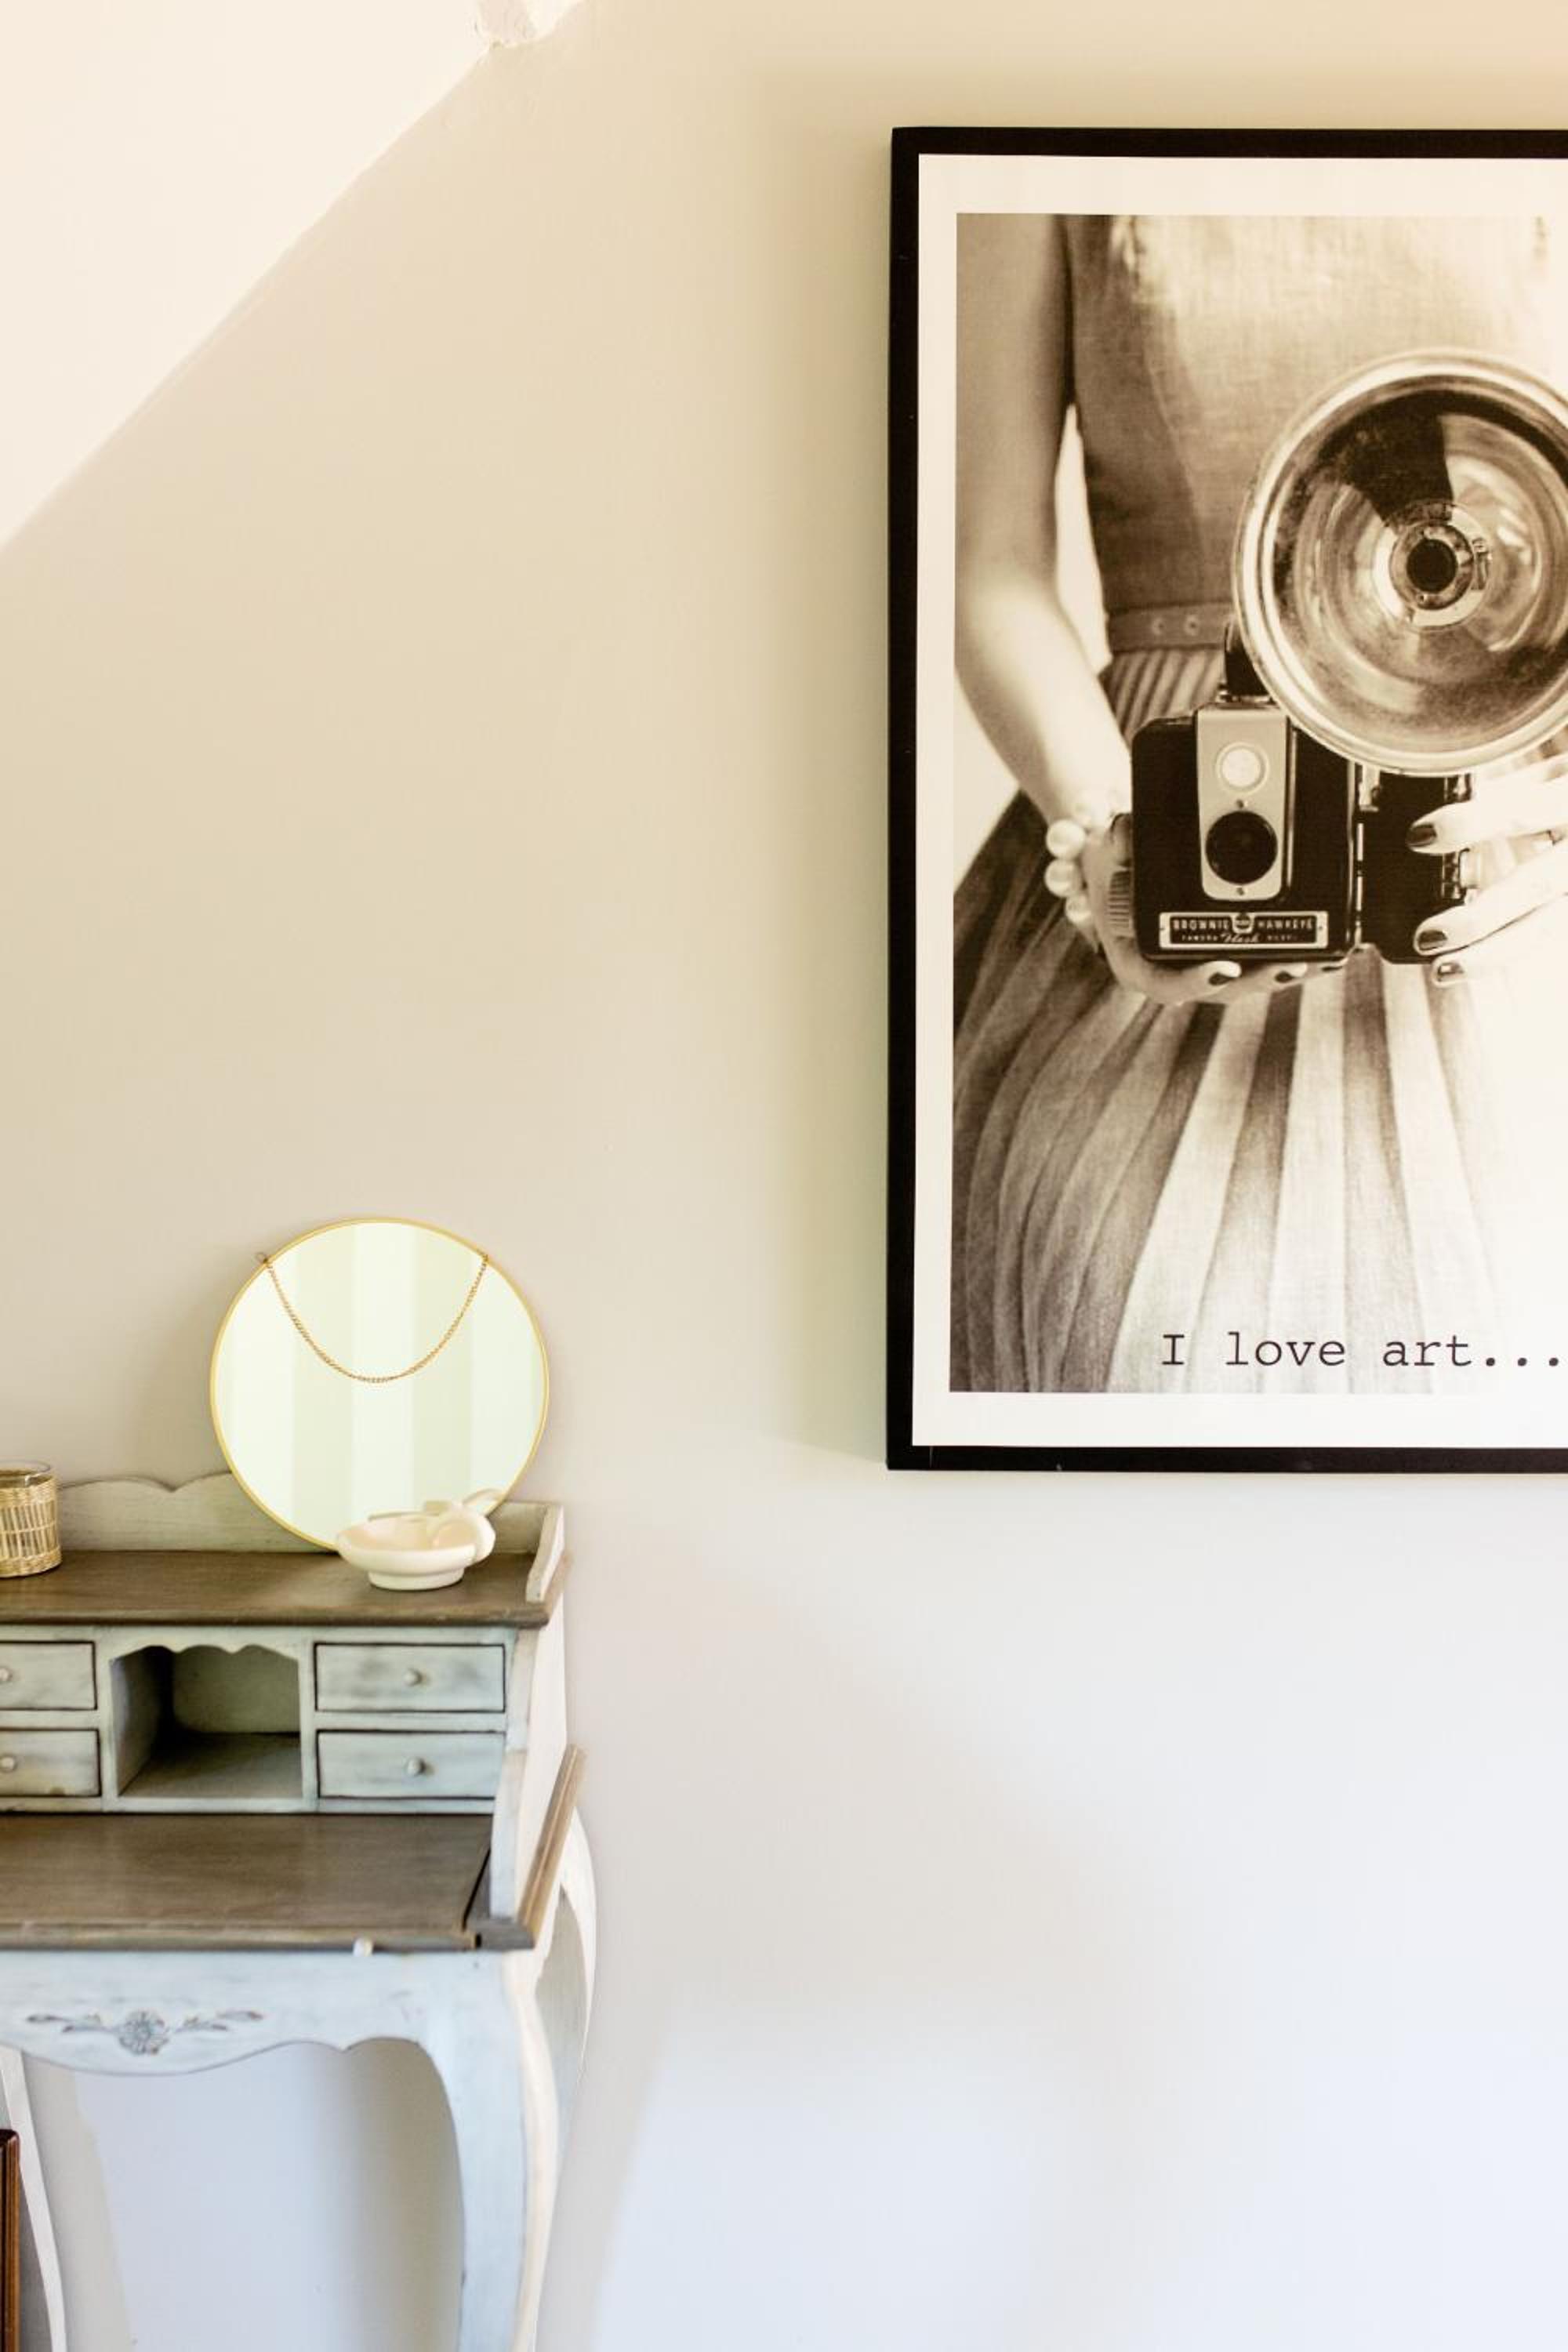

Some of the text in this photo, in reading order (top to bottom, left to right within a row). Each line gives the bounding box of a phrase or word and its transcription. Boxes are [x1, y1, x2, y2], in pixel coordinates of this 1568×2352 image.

[1172, 919, 1230, 931] BROWNIE
[1258, 917, 1313, 930] HAWKEYE
[1162, 1334, 1186, 1366] I
[1225, 1330, 1346, 1367] love
